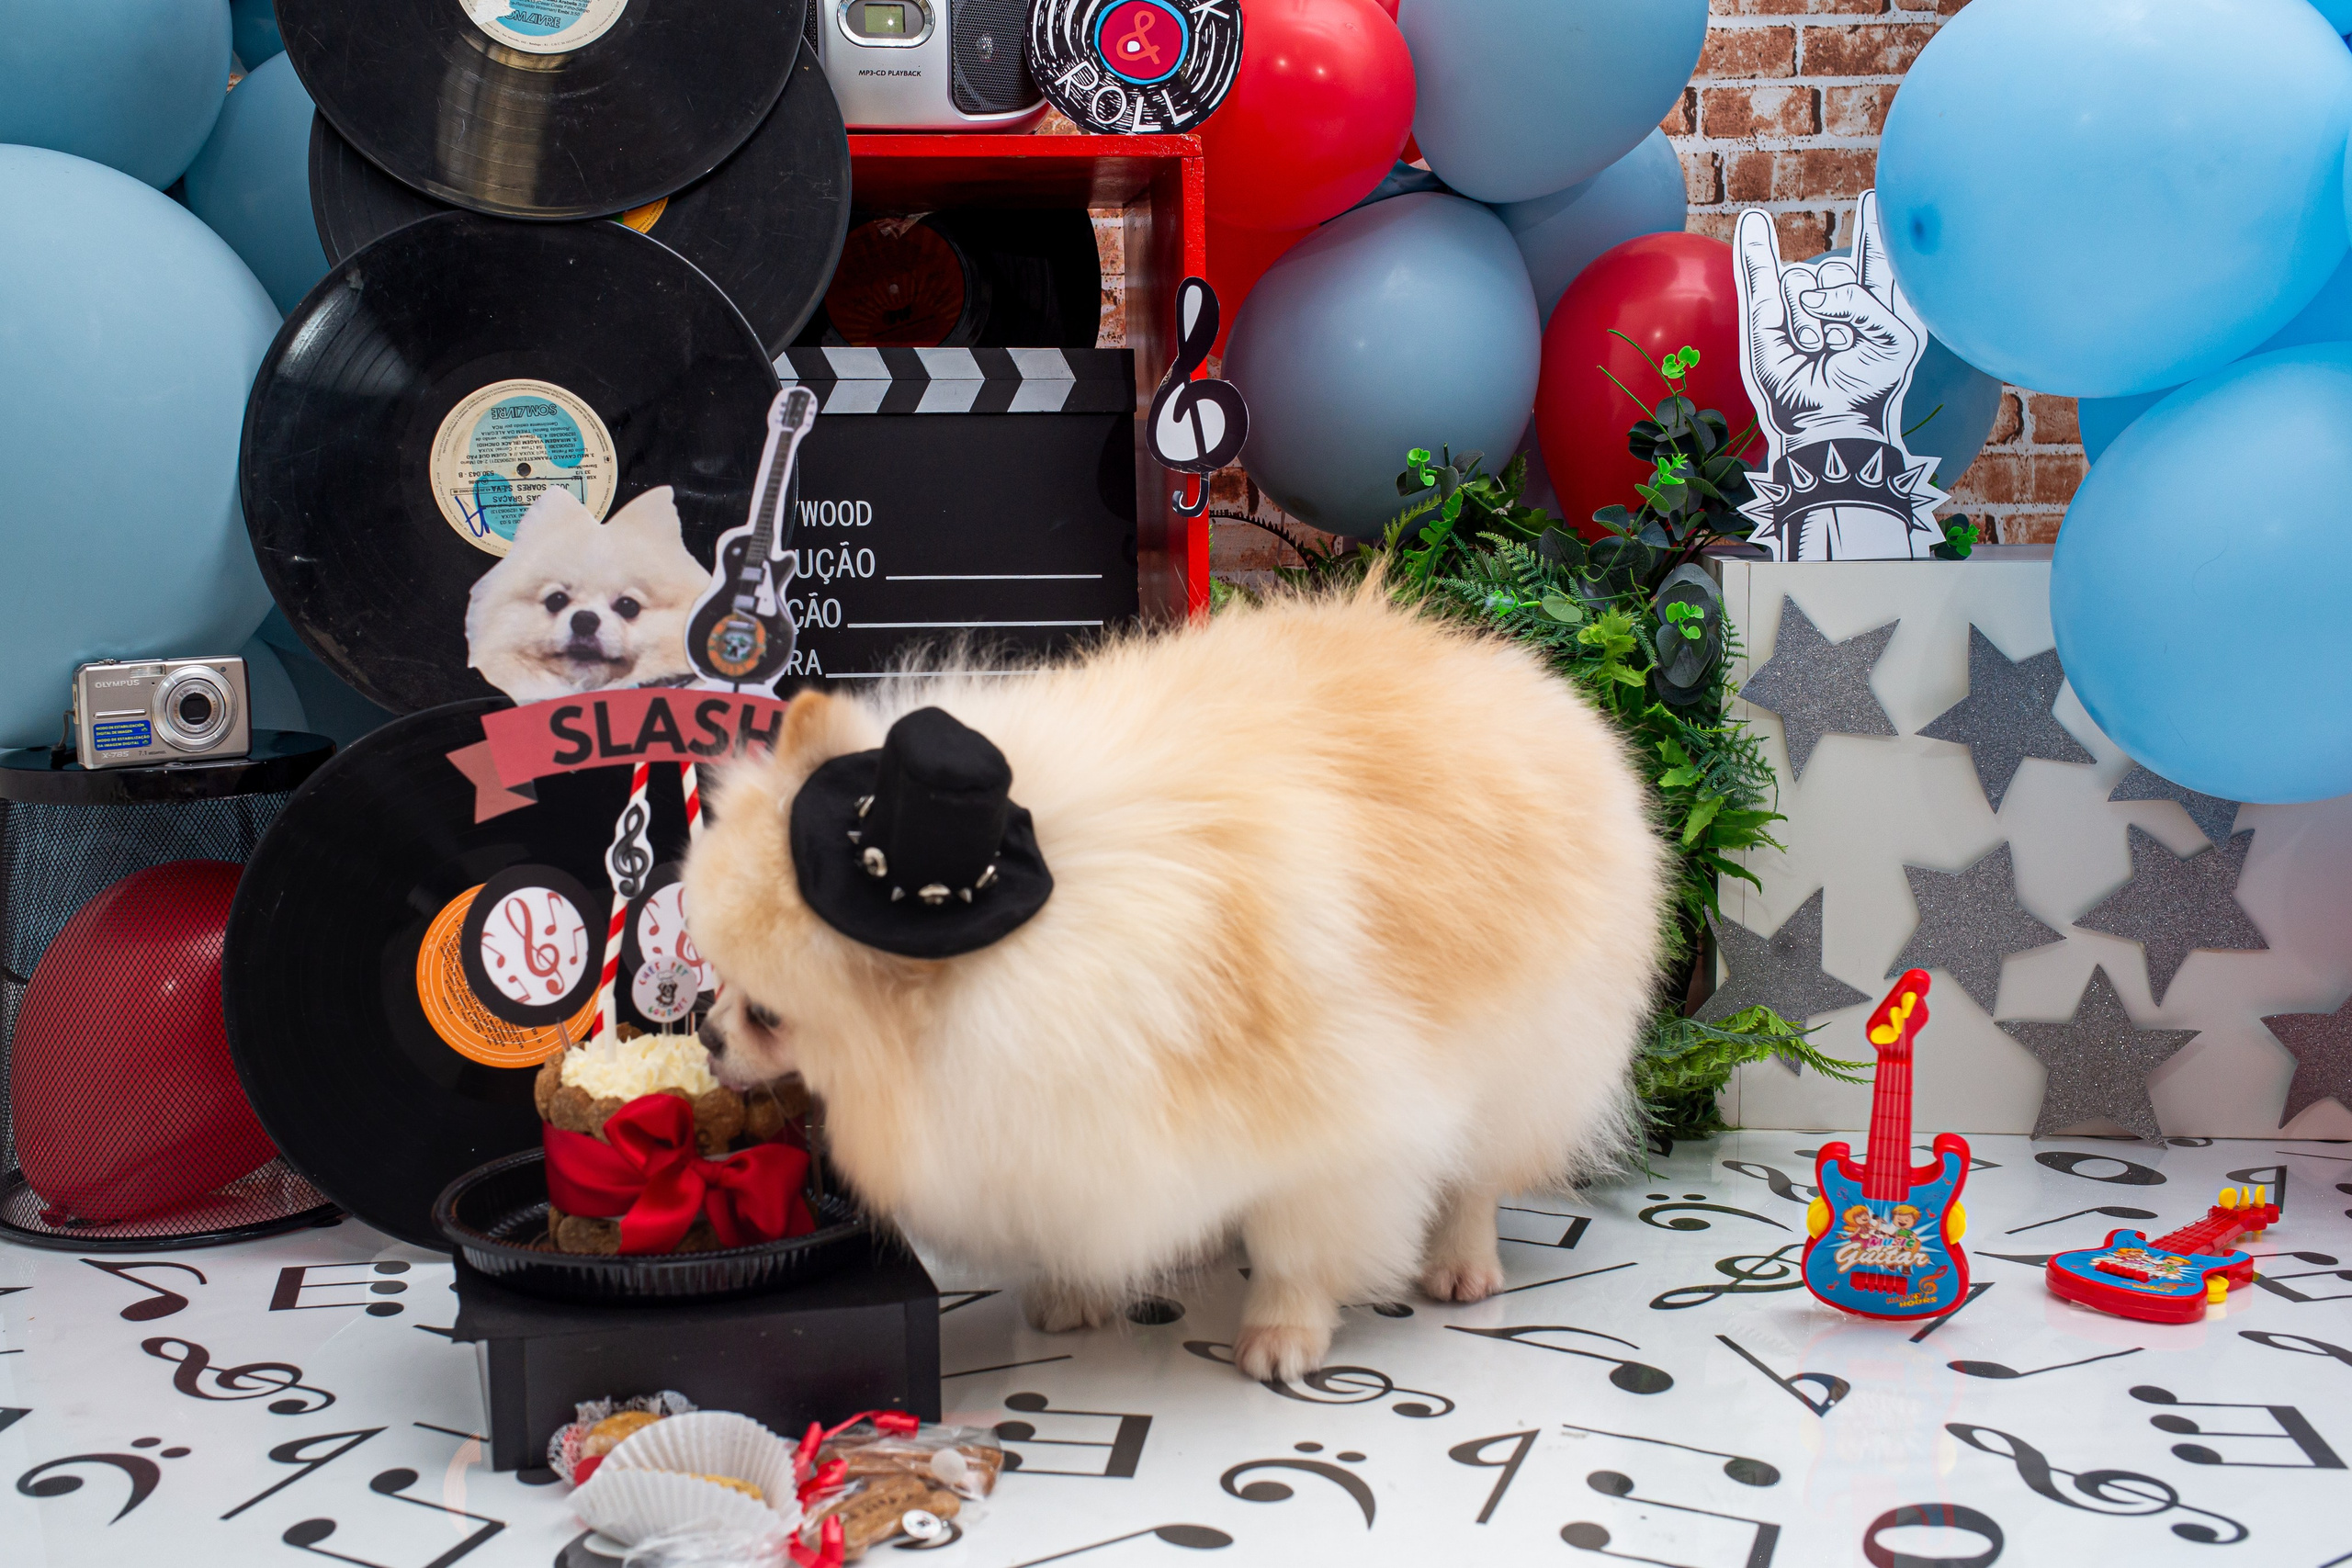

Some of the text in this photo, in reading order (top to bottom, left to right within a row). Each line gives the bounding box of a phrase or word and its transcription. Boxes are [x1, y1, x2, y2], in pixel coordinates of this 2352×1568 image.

[1116, 10, 1160, 65] &
[1054, 61, 1194, 132] ROLL
[492, 494, 522, 502] GRAÇAS
[516, 483, 546, 491] SOARES
[795, 541, 876, 585] UÇÃO
[786, 592, 842, 635] ÇÃO
[785, 649, 822, 676] RA
[95, 680, 140, 689] OLYMPUS
[549, 696, 784, 766] SLASH
[102, 750, 130, 759] X-785
[1868, 1237, 1916, 1247] MUSIC
[1835, 1241, 1929, 1273] Guitar
[1899, 1296, 1938, 1308] HOURS
